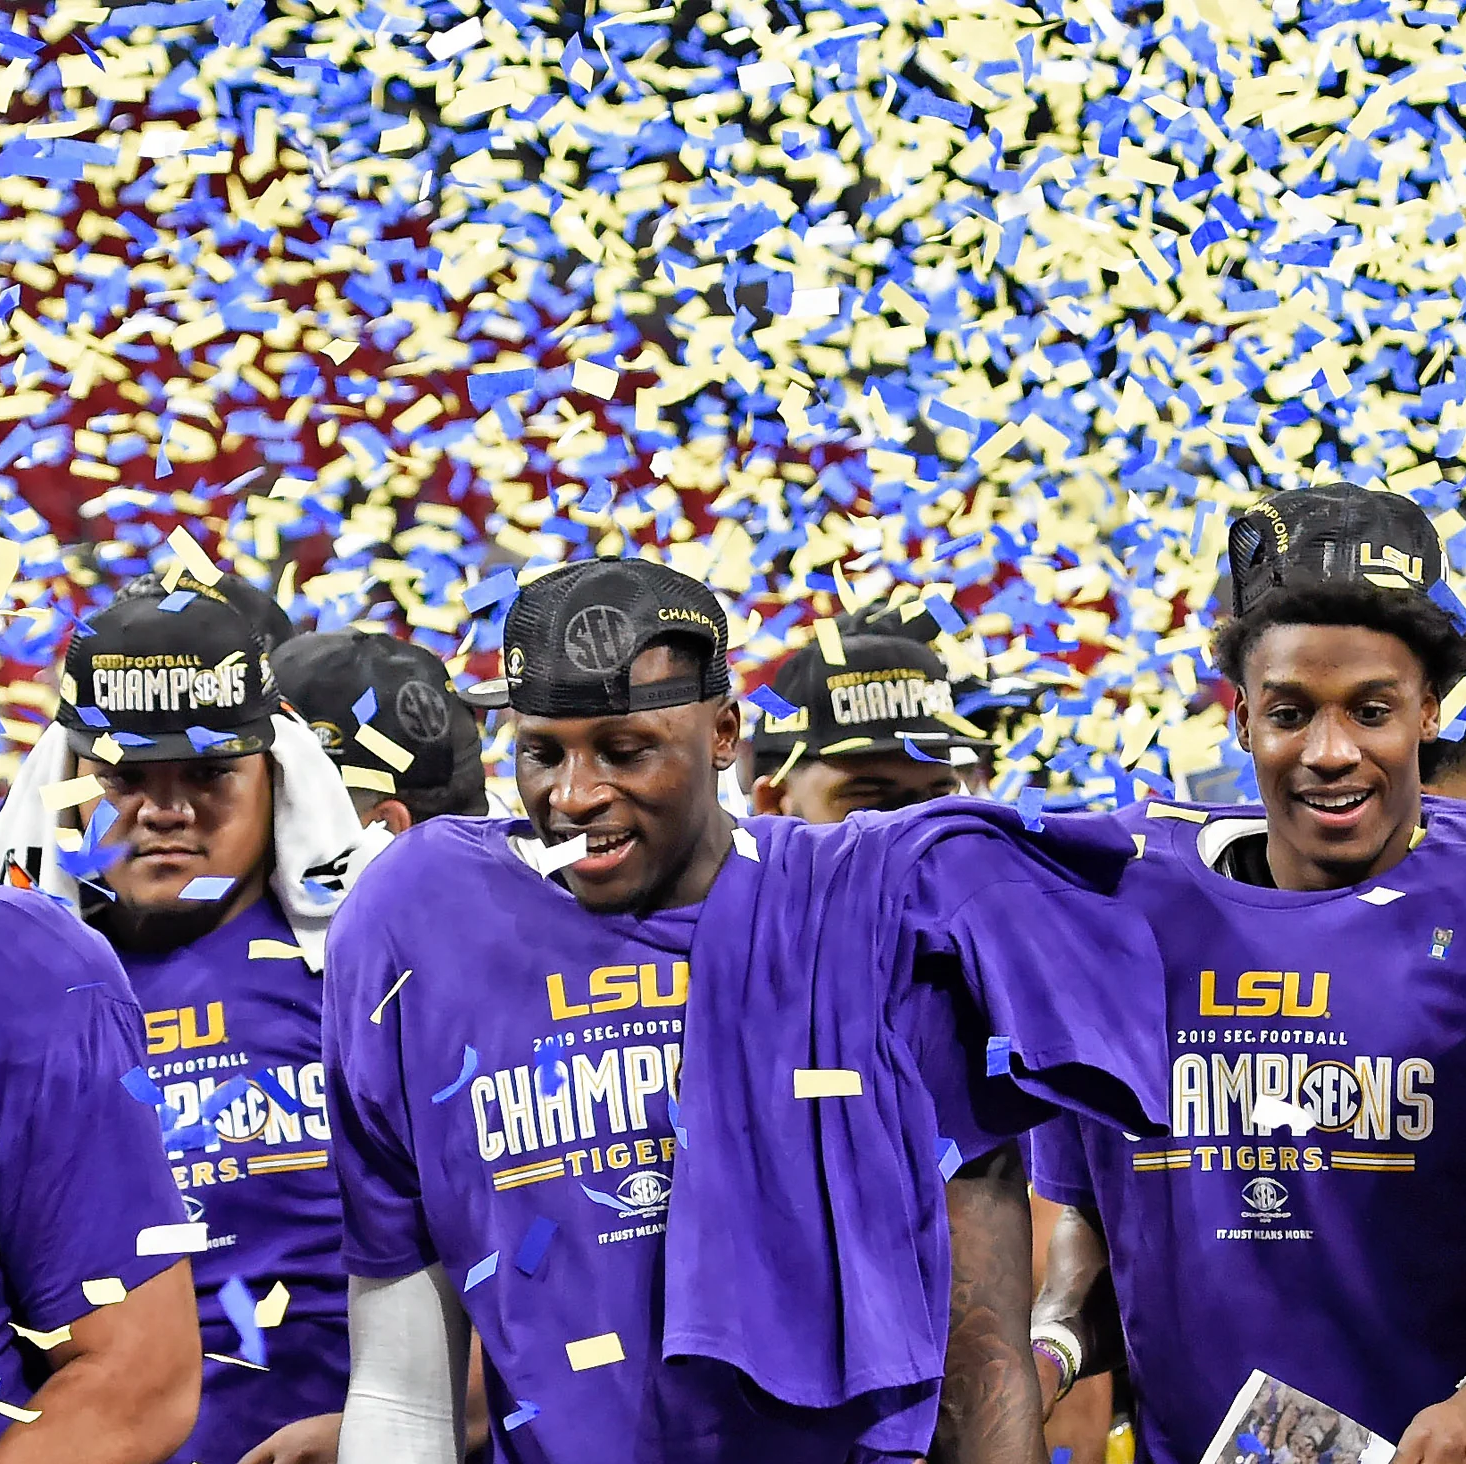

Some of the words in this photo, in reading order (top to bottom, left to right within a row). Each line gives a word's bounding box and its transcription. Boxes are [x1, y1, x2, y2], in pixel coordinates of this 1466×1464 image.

[1360, 542, 1423, 583] LSU
[126, 655, 202, 669] FOOTBALL
[546, 961, 690, 1021] LSU
[1200, 970, 1330, 1017] LSU
[144, 1001, 226, 1055] SU
[622, 1020, 683, 1038] FOOTB
[1177, 1030, 1216, 1044] 2019
[1260, 1030, 1348, 1046] FOOTBALL
[163, 1052, 249, 1077] FOOTBALL
[471, 1043, 682, 1161] CHAMPI
[1172, 1053, 1435, 1141] AMPIONS
[173, 1157, 239, 1189] ERS
[565, 1137, 678, 1177] TIGER
[609, 1228, 635, 1244] JUST
[635, 1223, 667, 1238] MEAN
[1227, 1229, 1252, 1240] JUST
